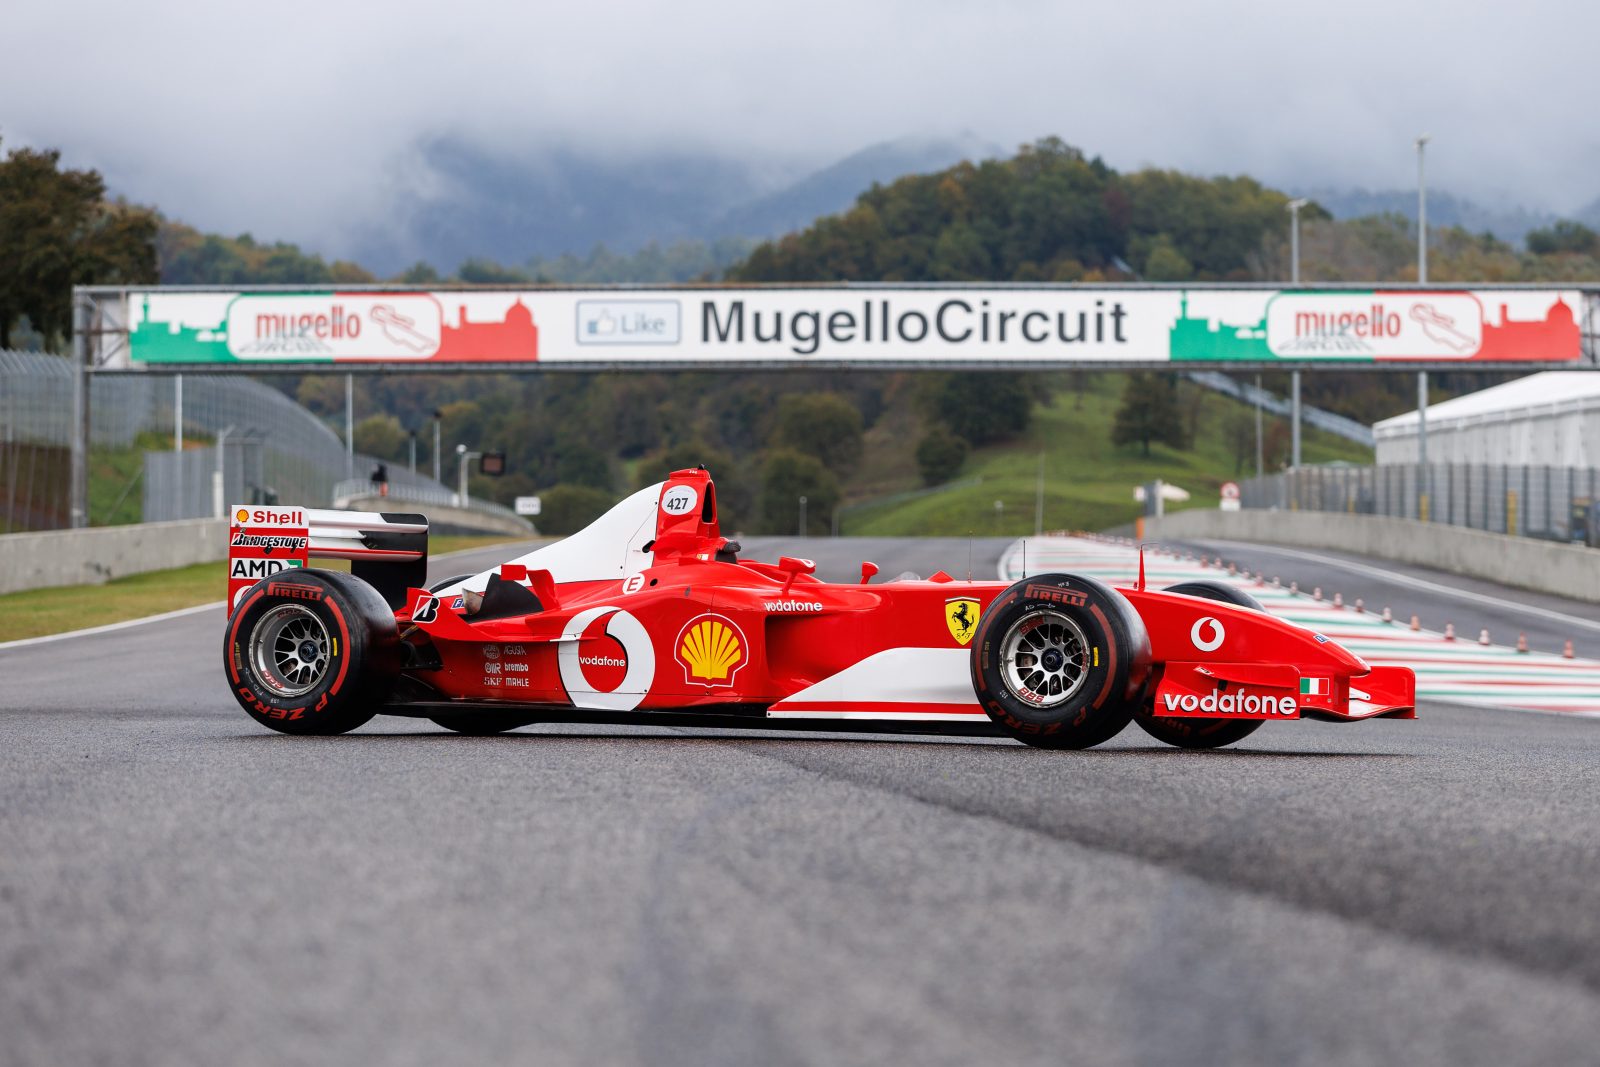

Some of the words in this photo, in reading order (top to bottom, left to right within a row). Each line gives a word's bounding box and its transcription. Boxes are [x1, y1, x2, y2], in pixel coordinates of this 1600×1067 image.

[256, 306, 361, 340] mugello
[621, 313, 666, 336] Like
[701, 299, 1128, 355] MugelloCircuit
[1296, 304, 1401, 337] mugello
[667, 497, 689, 510] 427
[253, 511, 302, 524] Shell
[232, 559, 283, 578] AMD
[267, 581, 323, 601] PIRELLI
[627, 577, 641, 591] E
[1024, 583, 1088, 607] PIRELLI
[764, 599, 823, 612] vodafone
[504, 662, 529, 672] brembo
[579, 656, 626, 667] vodafone
[505, 677, 530, 687] MAHLE
[238, 687, 307, 721] ZERO
[1164, 688, 1298, 715] vodafone
